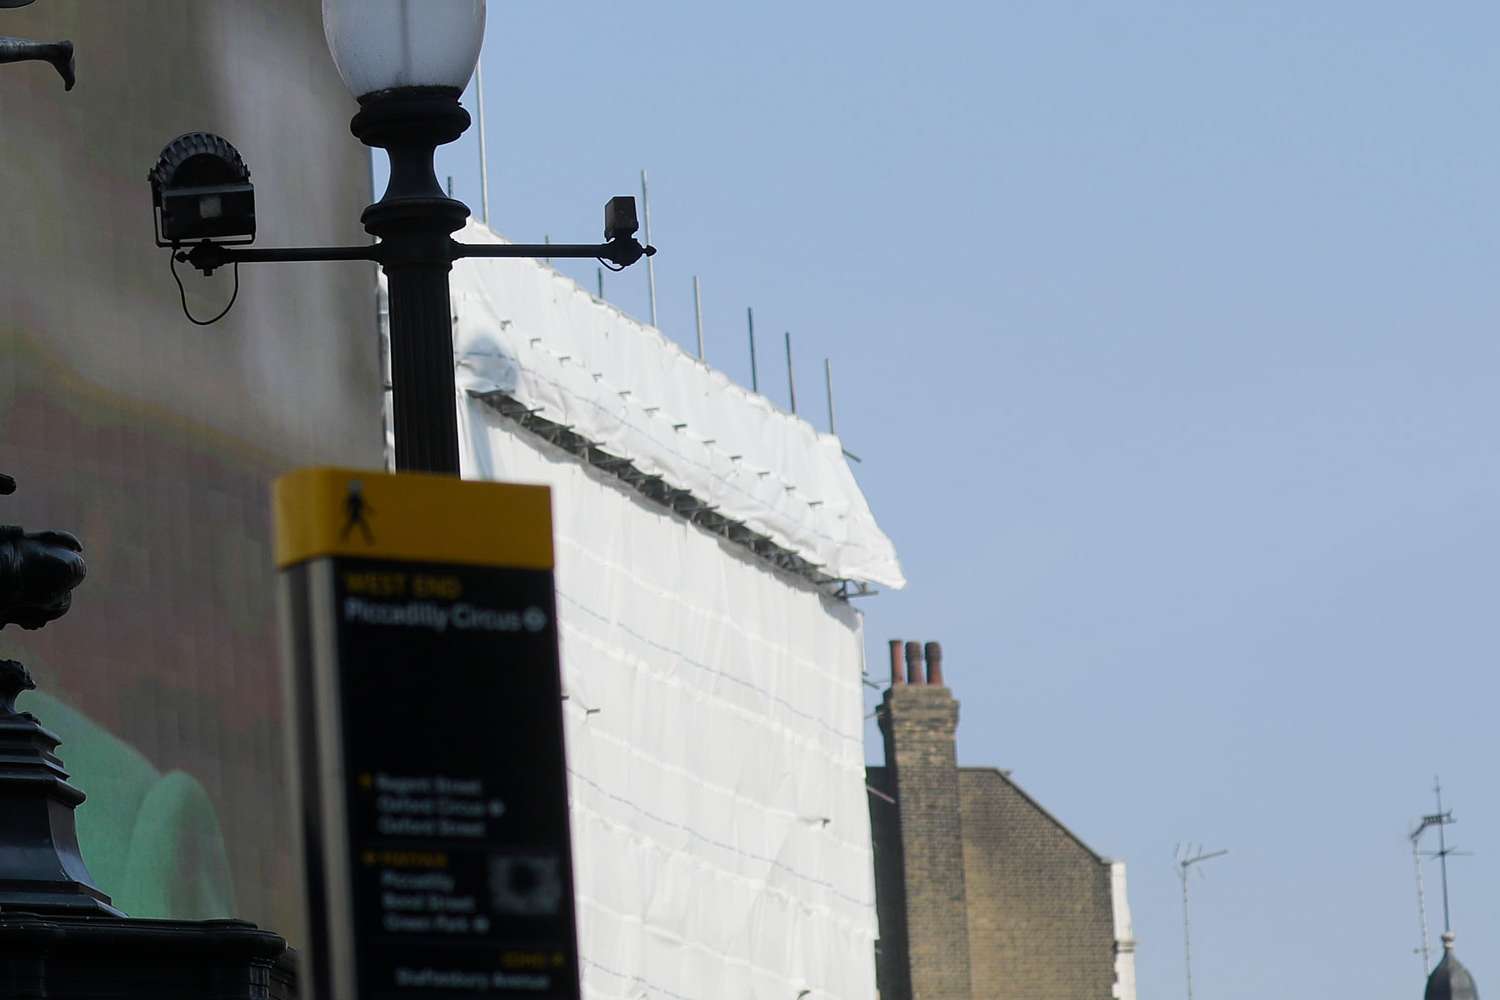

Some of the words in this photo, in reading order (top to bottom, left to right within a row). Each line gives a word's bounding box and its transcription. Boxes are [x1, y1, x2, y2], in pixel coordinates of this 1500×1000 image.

[345, 572, 407, 597] WEST
[412, 574, 462, 599] END
[344, 597, 449, 632] Piccadilly
[450, 602, 522, 631] Circus
[434, 775, 482, 796] Street
[376, 794, 434, 814] Oxford
[378, 815, 435, 835] Oxford
[437, 817, 487, 837] Street
[428, 893, 476, 912] Street
